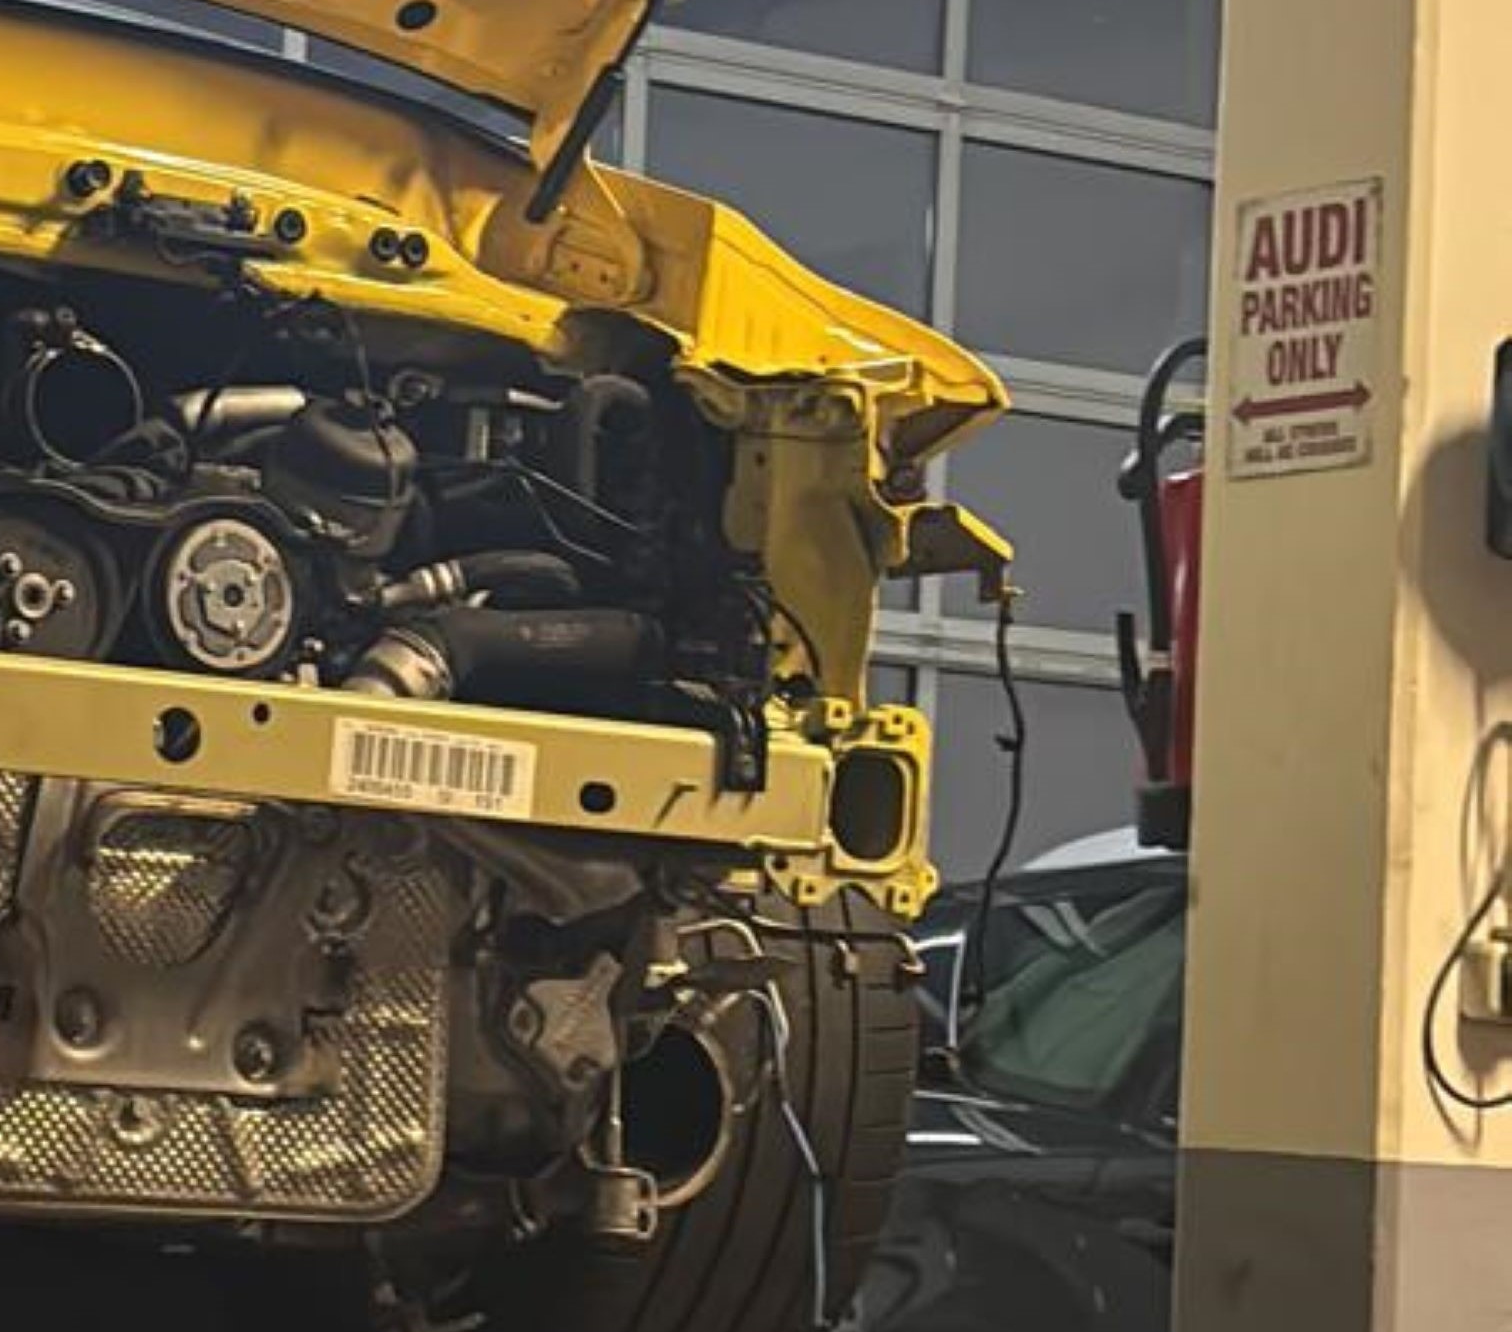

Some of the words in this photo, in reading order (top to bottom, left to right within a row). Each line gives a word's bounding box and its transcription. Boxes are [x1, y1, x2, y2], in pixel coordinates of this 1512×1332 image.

[1246, 198, 1367, 281] AUDI
[1241, 273, 1372, 336] PARKING
[1266, 334, 1343, 385] ONLY
